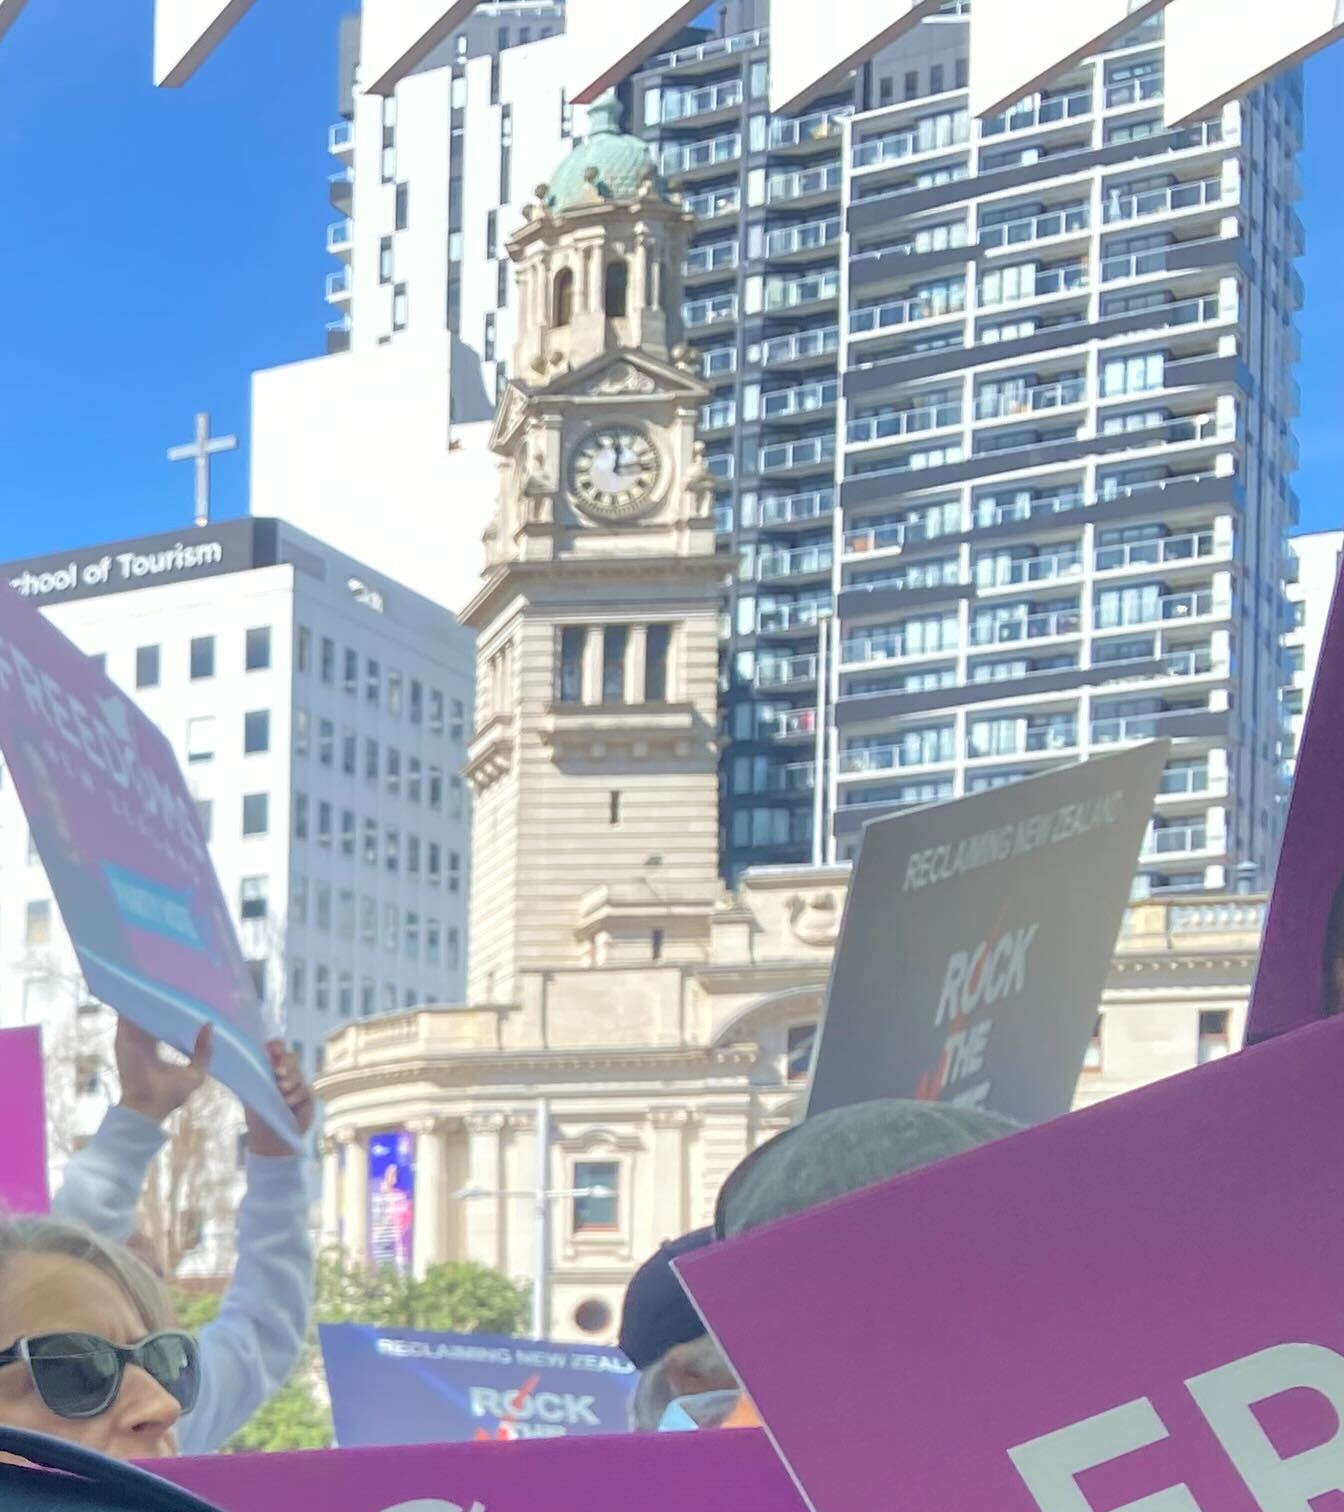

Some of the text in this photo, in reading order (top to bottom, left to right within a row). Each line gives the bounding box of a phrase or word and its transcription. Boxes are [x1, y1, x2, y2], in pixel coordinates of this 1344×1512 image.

[83, 555, 112, 585] of
[117, 540, 223, 579] Tourism
[934, 921, 1041, 1028] ROCK
[940, 1018, 993, 1088] THE
[376, 1337, 512, 1365] RECLAIMING
[516, 1349, 564, 1369] NEW
[469, 1385, 601, 1426] ROCK
